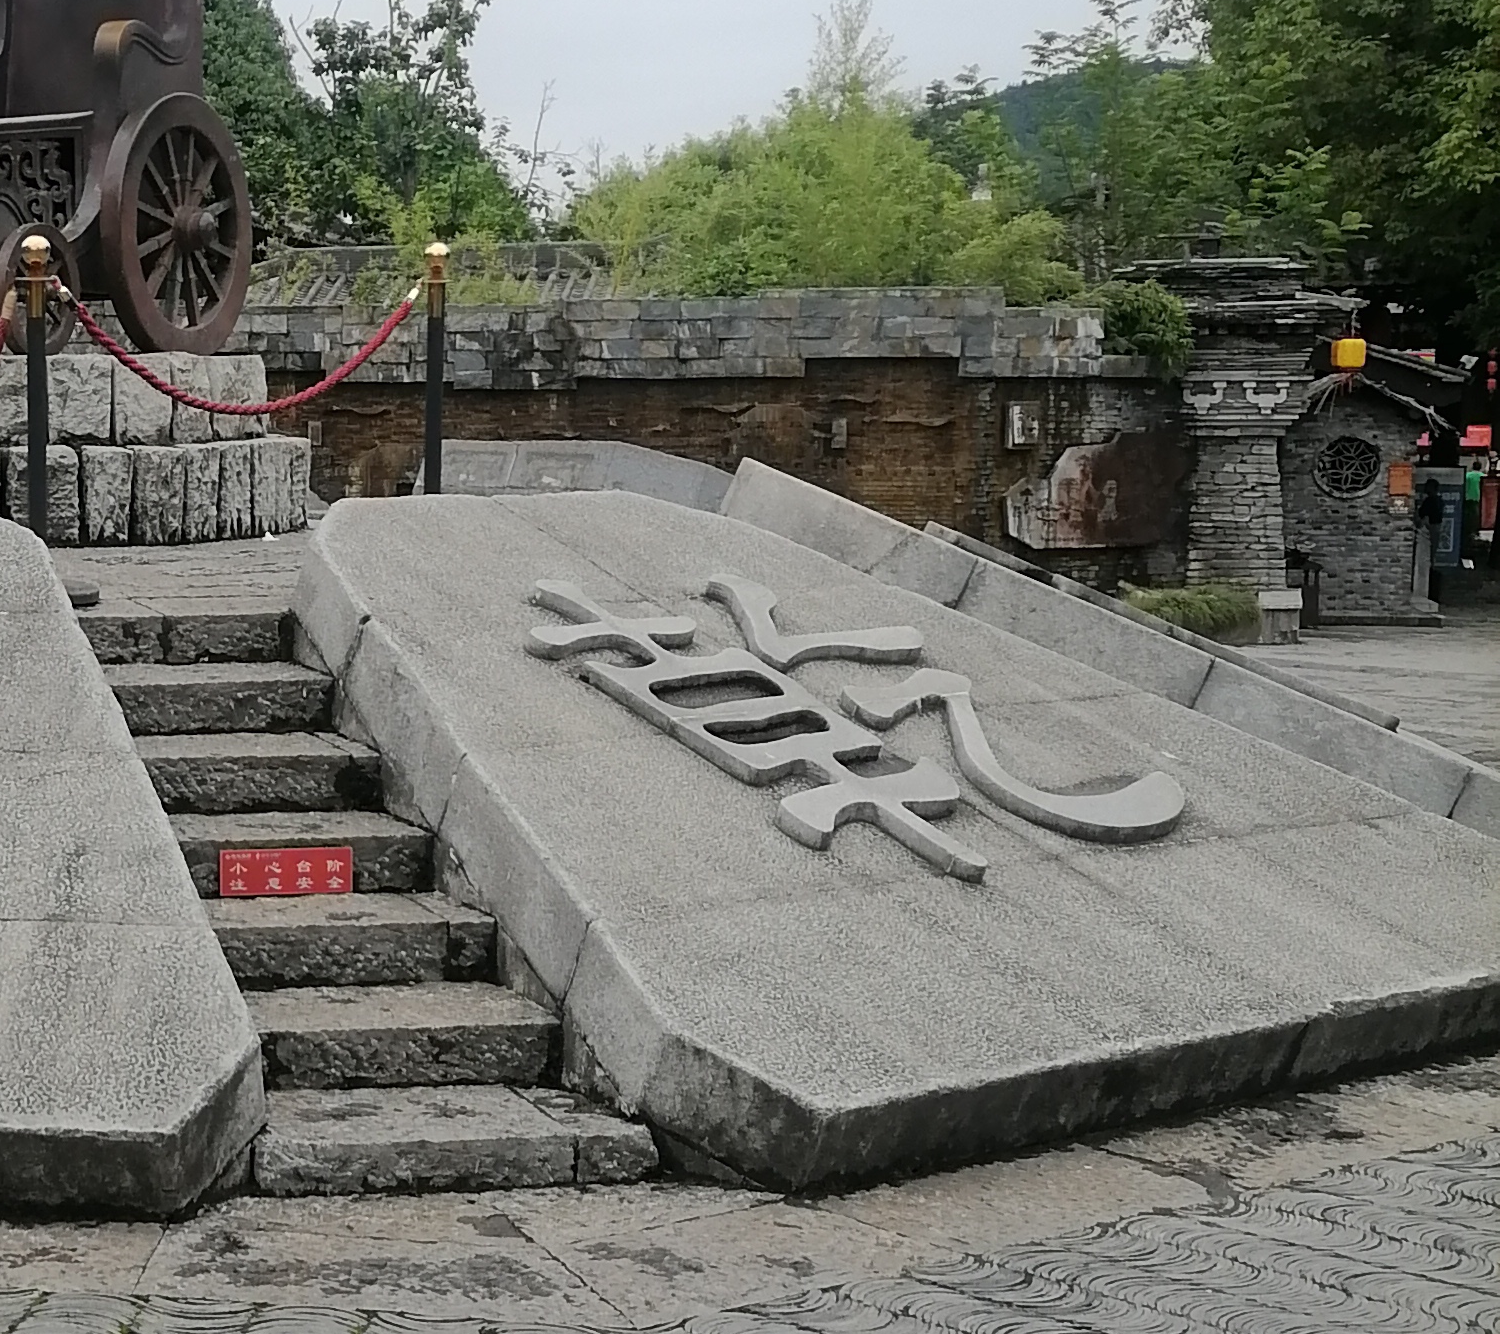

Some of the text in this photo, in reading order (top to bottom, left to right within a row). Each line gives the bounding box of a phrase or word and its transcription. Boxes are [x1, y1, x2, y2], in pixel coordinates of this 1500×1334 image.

[524, 573, 1184, 883] 乾
[229, 860, 344, 875] 小心台阶
[229, 875, 344, 890] 注意安全
